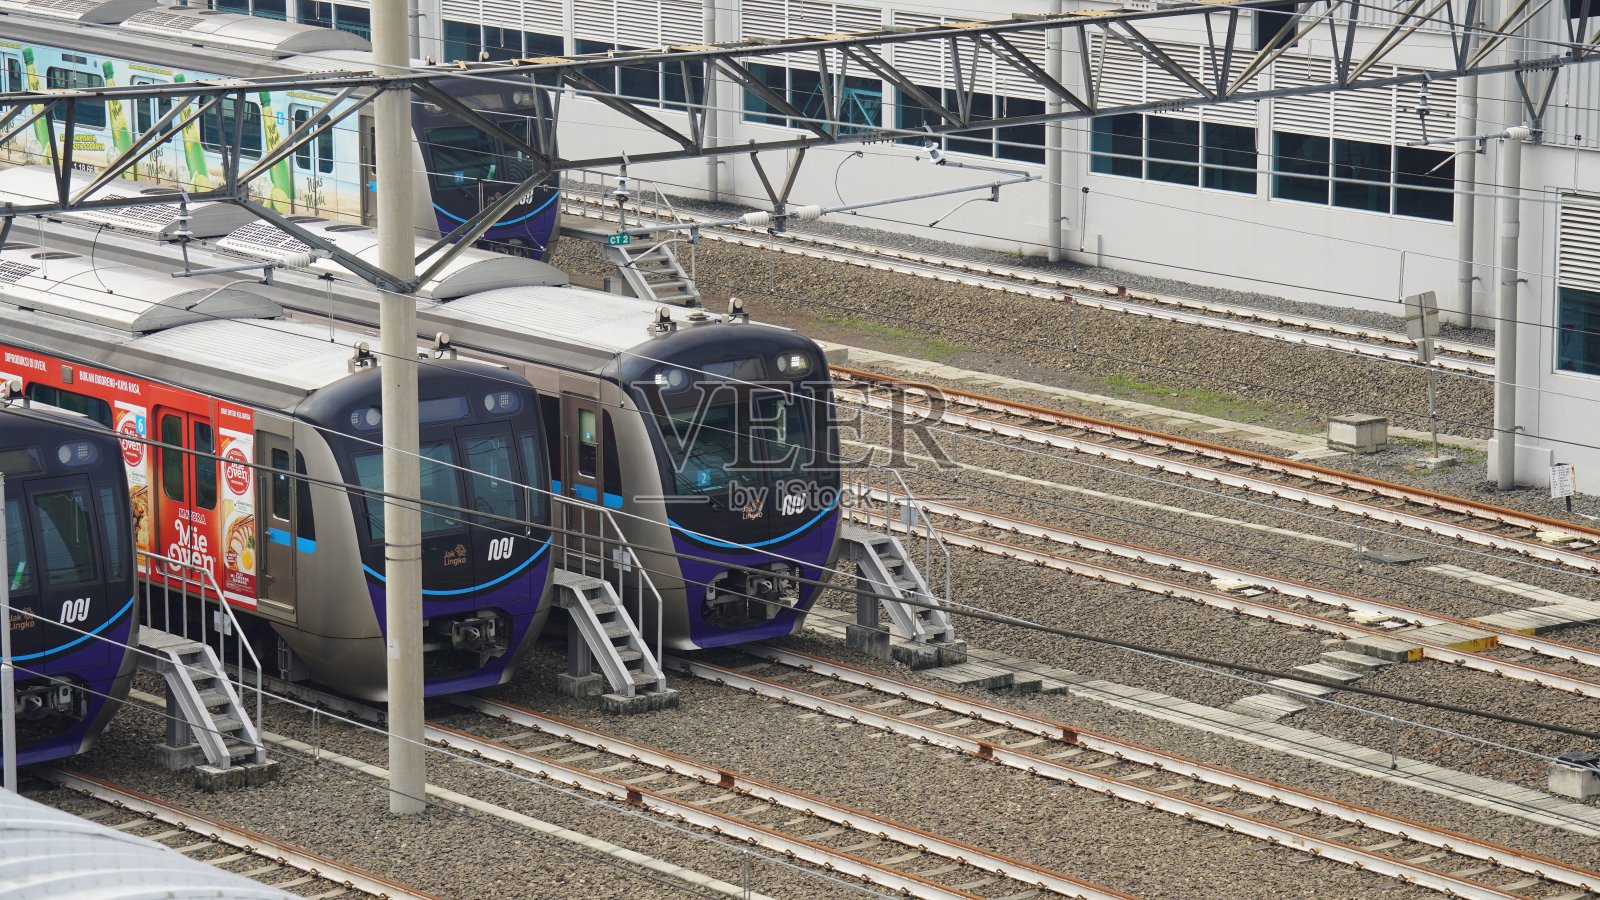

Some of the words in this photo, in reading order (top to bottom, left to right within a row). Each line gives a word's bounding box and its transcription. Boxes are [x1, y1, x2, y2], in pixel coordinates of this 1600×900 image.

[610, 236, 620, 244] CT
[623, 235, 628, 243] 2
[138, 418, 144, 433] 6
[227, 467, 249, 482] Oven
[701, 473, 706, 483] 2
[175, 519, 208, 553] Mie
[168, 543, 214, 578] Oven
[444, 557, 466, 567] Lingko
